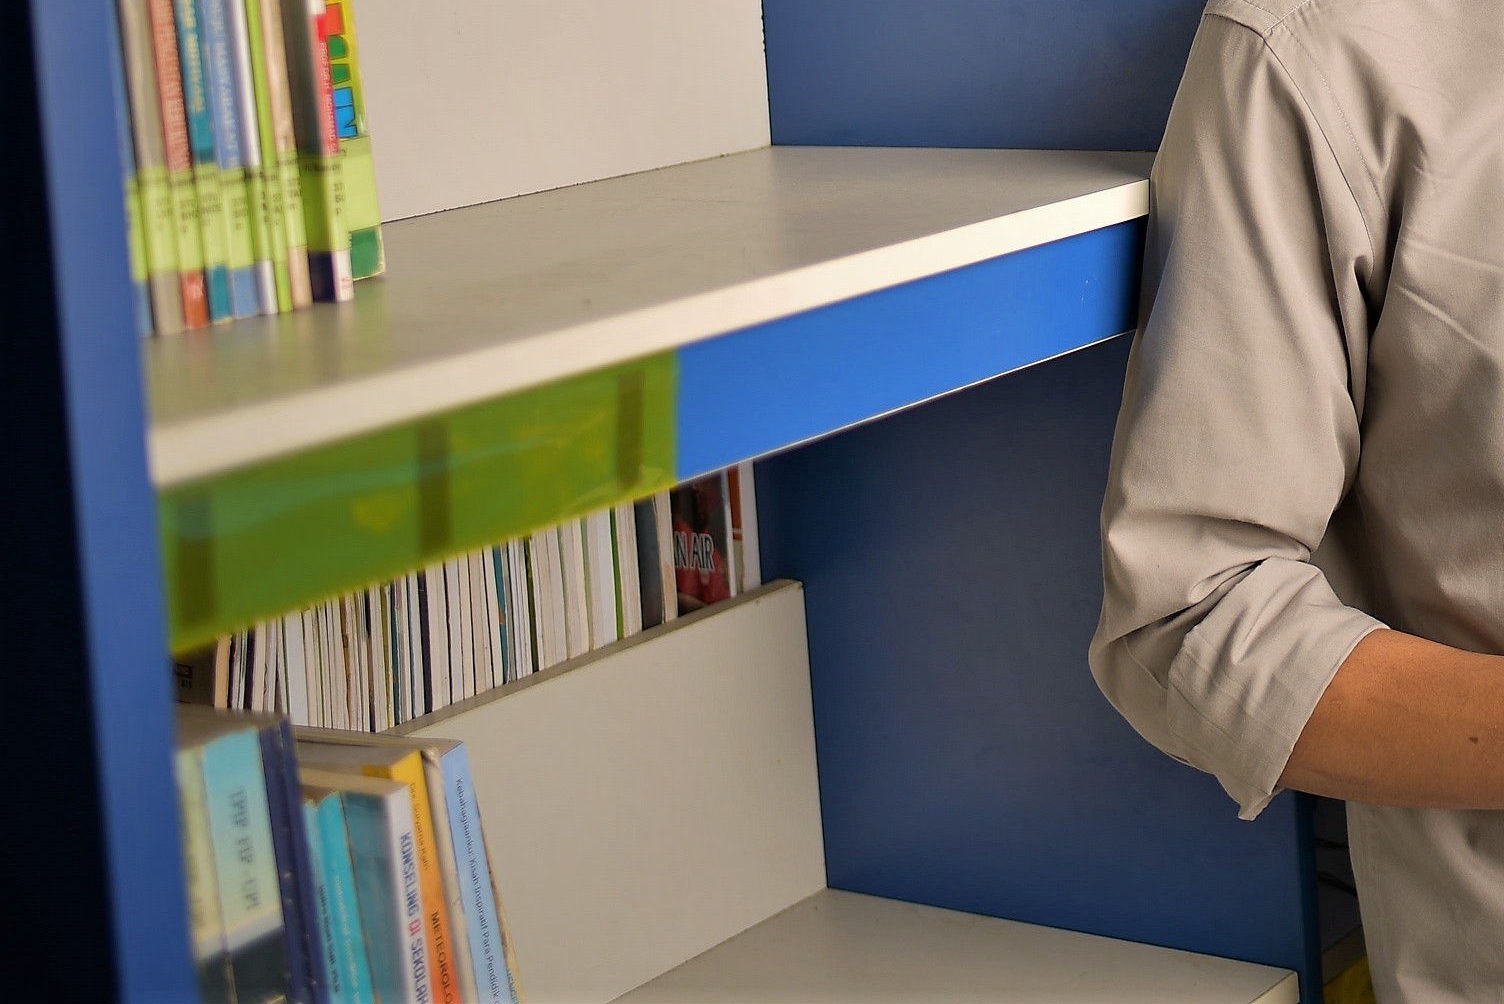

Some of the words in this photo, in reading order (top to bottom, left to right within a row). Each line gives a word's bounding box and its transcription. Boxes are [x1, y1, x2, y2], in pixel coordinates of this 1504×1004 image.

[453, 778, 476, 855] Kebahagiaanku:
[399, 831, 418, 916] KONSELING
[469, 858, 480, 885] Kisah
[408, 918, 420, 935] DI
[473, 887, 488, 930] Inspiratif
[481, 932, 491, 954] Para
[485, 956, 499, 998] Pendidik
